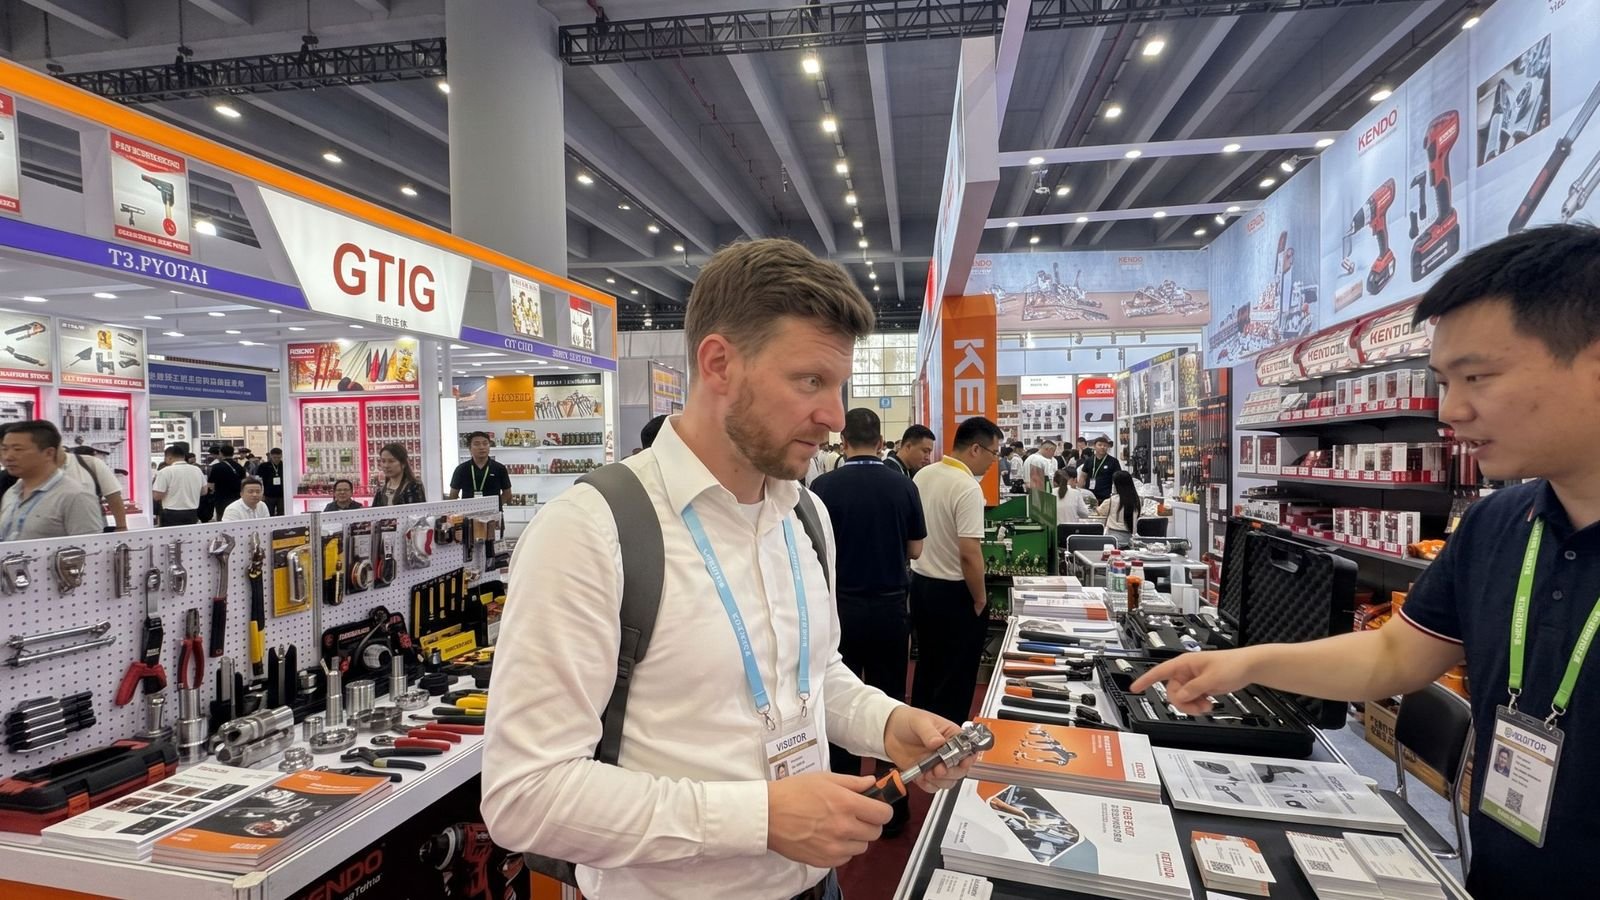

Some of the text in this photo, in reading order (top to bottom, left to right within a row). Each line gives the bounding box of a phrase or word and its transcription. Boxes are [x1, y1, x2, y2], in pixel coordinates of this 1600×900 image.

[1358, 109, 1397, 151] KENDO
[108, 248, 208, 285] T3.PYOTAI
[333, 242, 435, 312] GTIG
[1118, 256, 1144, 264] KENDO
[954, 338, 985, 424] KE
